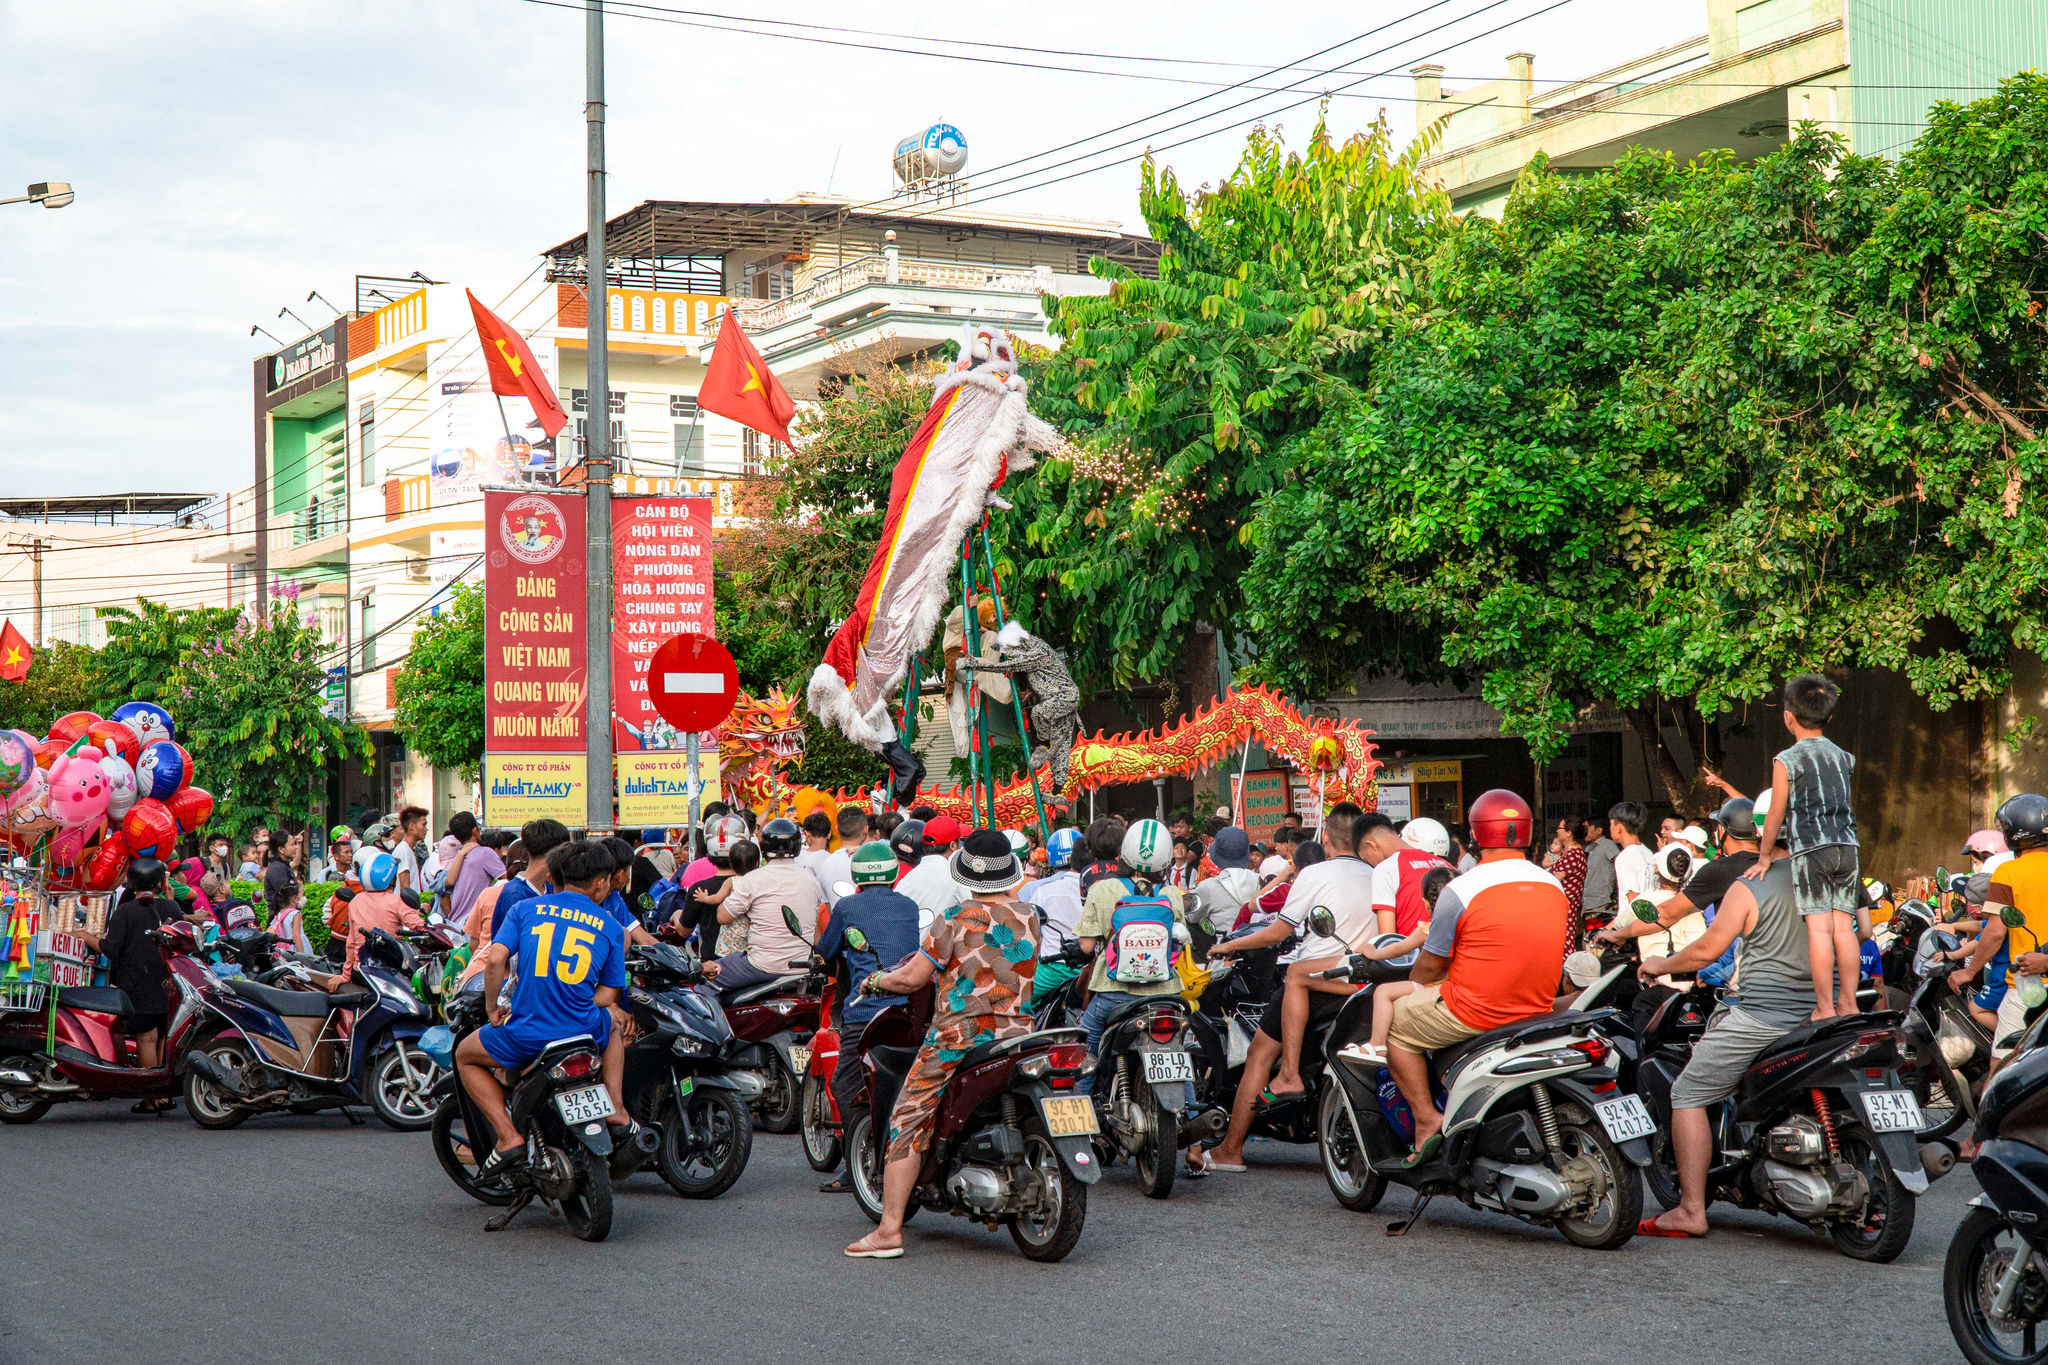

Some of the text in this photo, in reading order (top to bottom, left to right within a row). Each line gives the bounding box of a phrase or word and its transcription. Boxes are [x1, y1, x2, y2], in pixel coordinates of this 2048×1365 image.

[635, 504, 689, 520] CÁN BỘ
[632, 523, 693, 539] HỘI VIÊN
[625, 542, 701, 556] NÔNG DÂN
[634, 561, 693, 575] PHƯỜNG
[516, 570, 556, 597] ĐẢNG
[622, 581, 705, 595] HÒA HƯƠNG
[625, 602, 703, 614] CHUNG TAY
[500, 606, 572, 636] CỘNG SẢN
[628, 620, 701, 636] XÂY DỰNG
[628, 638, 657, 653] NẾP
[502, 642, 570, 671] VIỆT NAM
[634, 658, 650, 672] VĂ
[494, 681, 579, 704] QUANG VINH
[630, 678, 648, 692] VĂ
[494, 712, 579, 736] MUÔN NĂM!
[502, 762, 524, 771] CÔNG
[538, 761, 548, 771] CỔ
[550, 761, 570, 771] PHẦN
[635, 762, 656, 770] CÔNG
[671, 759, 681, 769] CỔ
[1417, 766, 1432, 778] Ship
[1246, 812, 1285, 826] HEO QUAY
[536, 904, 604, 931] T.T.BÌNH
[52, 932, 70, 954] KEM
[1125, 939, 1162, 947] BABY
[531, 922, 596, 985] 15
[1150, 1053, 1185, 1066] 88-LD
[1149, 1066, 1191, 1080] 000.72
[564, 1088, 600, 1106] 92-B1
[1870, 1094, 1908, 1110] 92-N1
[565, 1100, 611, 1121] 526.54
[1604, 1100, 1638, 1121] 92-N1
[1051, 1116, 1096, 1134] 330.74
[1608, 1115, 1652, 1140] 740.73
[1871, 1111, 1919, 1128] 562.71
